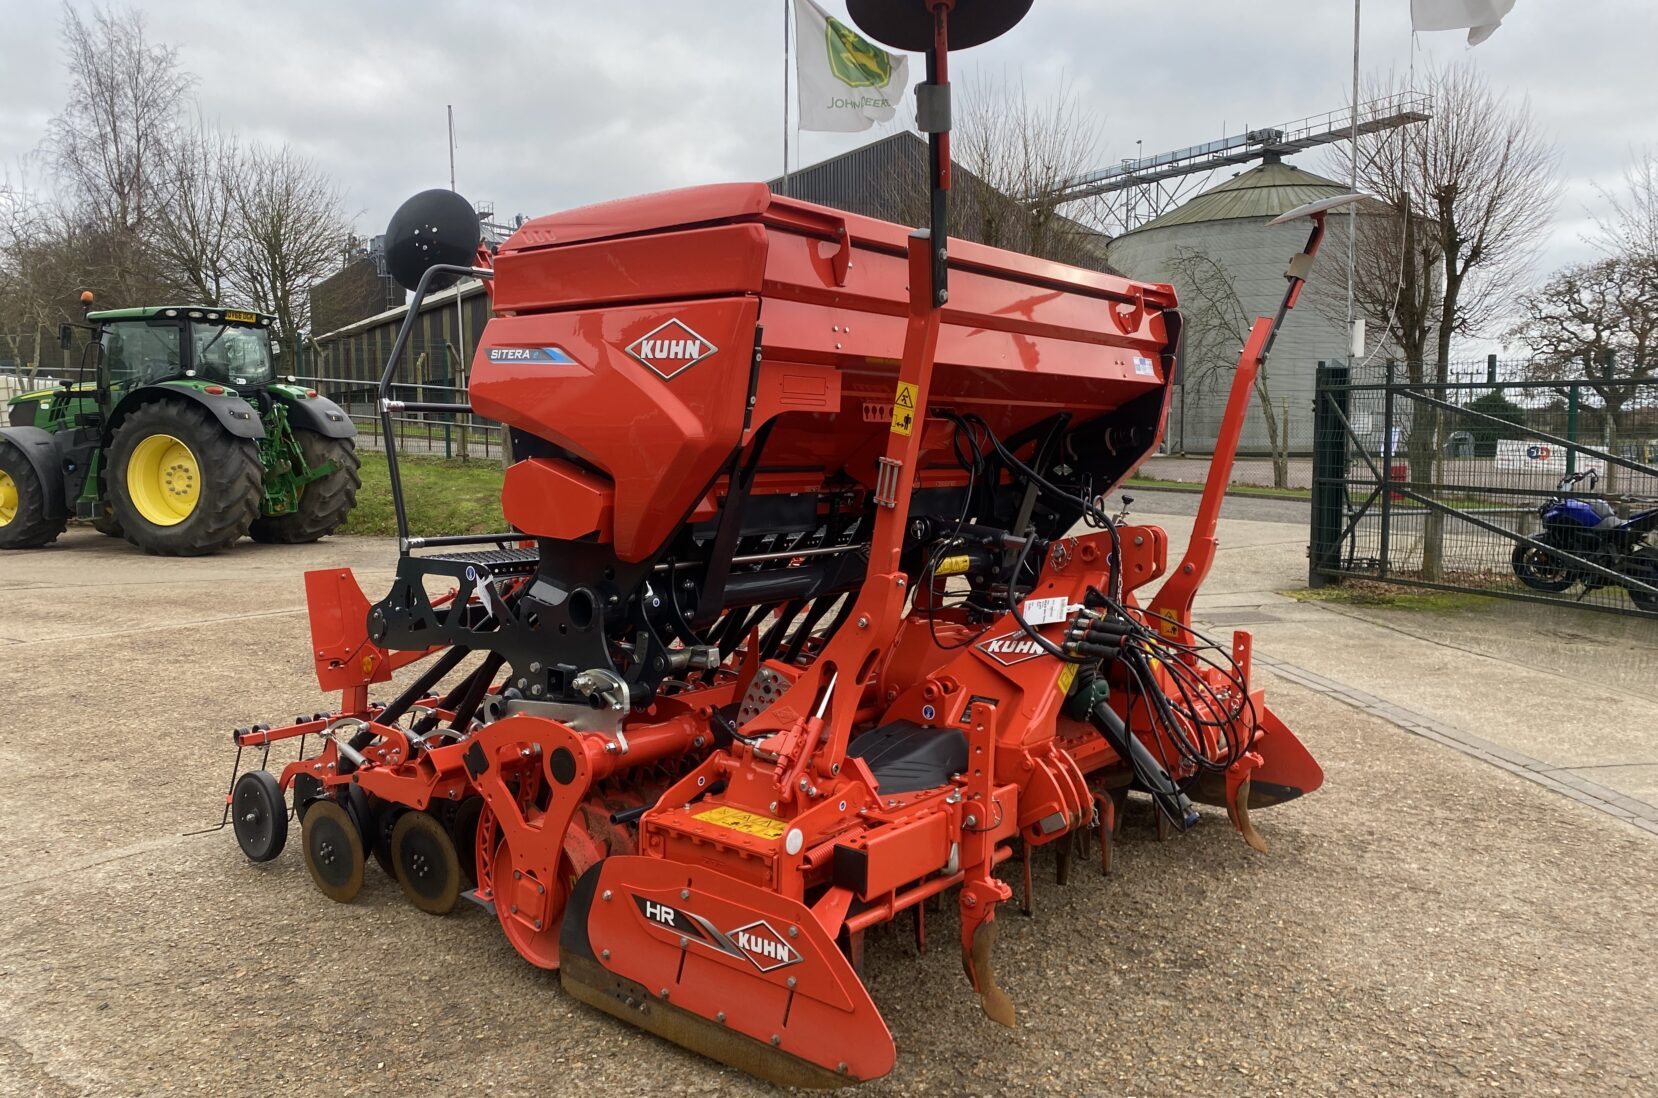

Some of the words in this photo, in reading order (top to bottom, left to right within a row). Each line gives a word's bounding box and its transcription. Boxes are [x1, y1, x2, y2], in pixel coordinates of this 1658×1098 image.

[827, 97, 860, 109] JOHN
[490, 349, 531, 359] SITERA
[640, 339, 701, 360] KUHN
[987, 640, 1045, 655] KUHN
[646, 900, 676, 927] HR
[738, 931, 789, 963] KUHN
